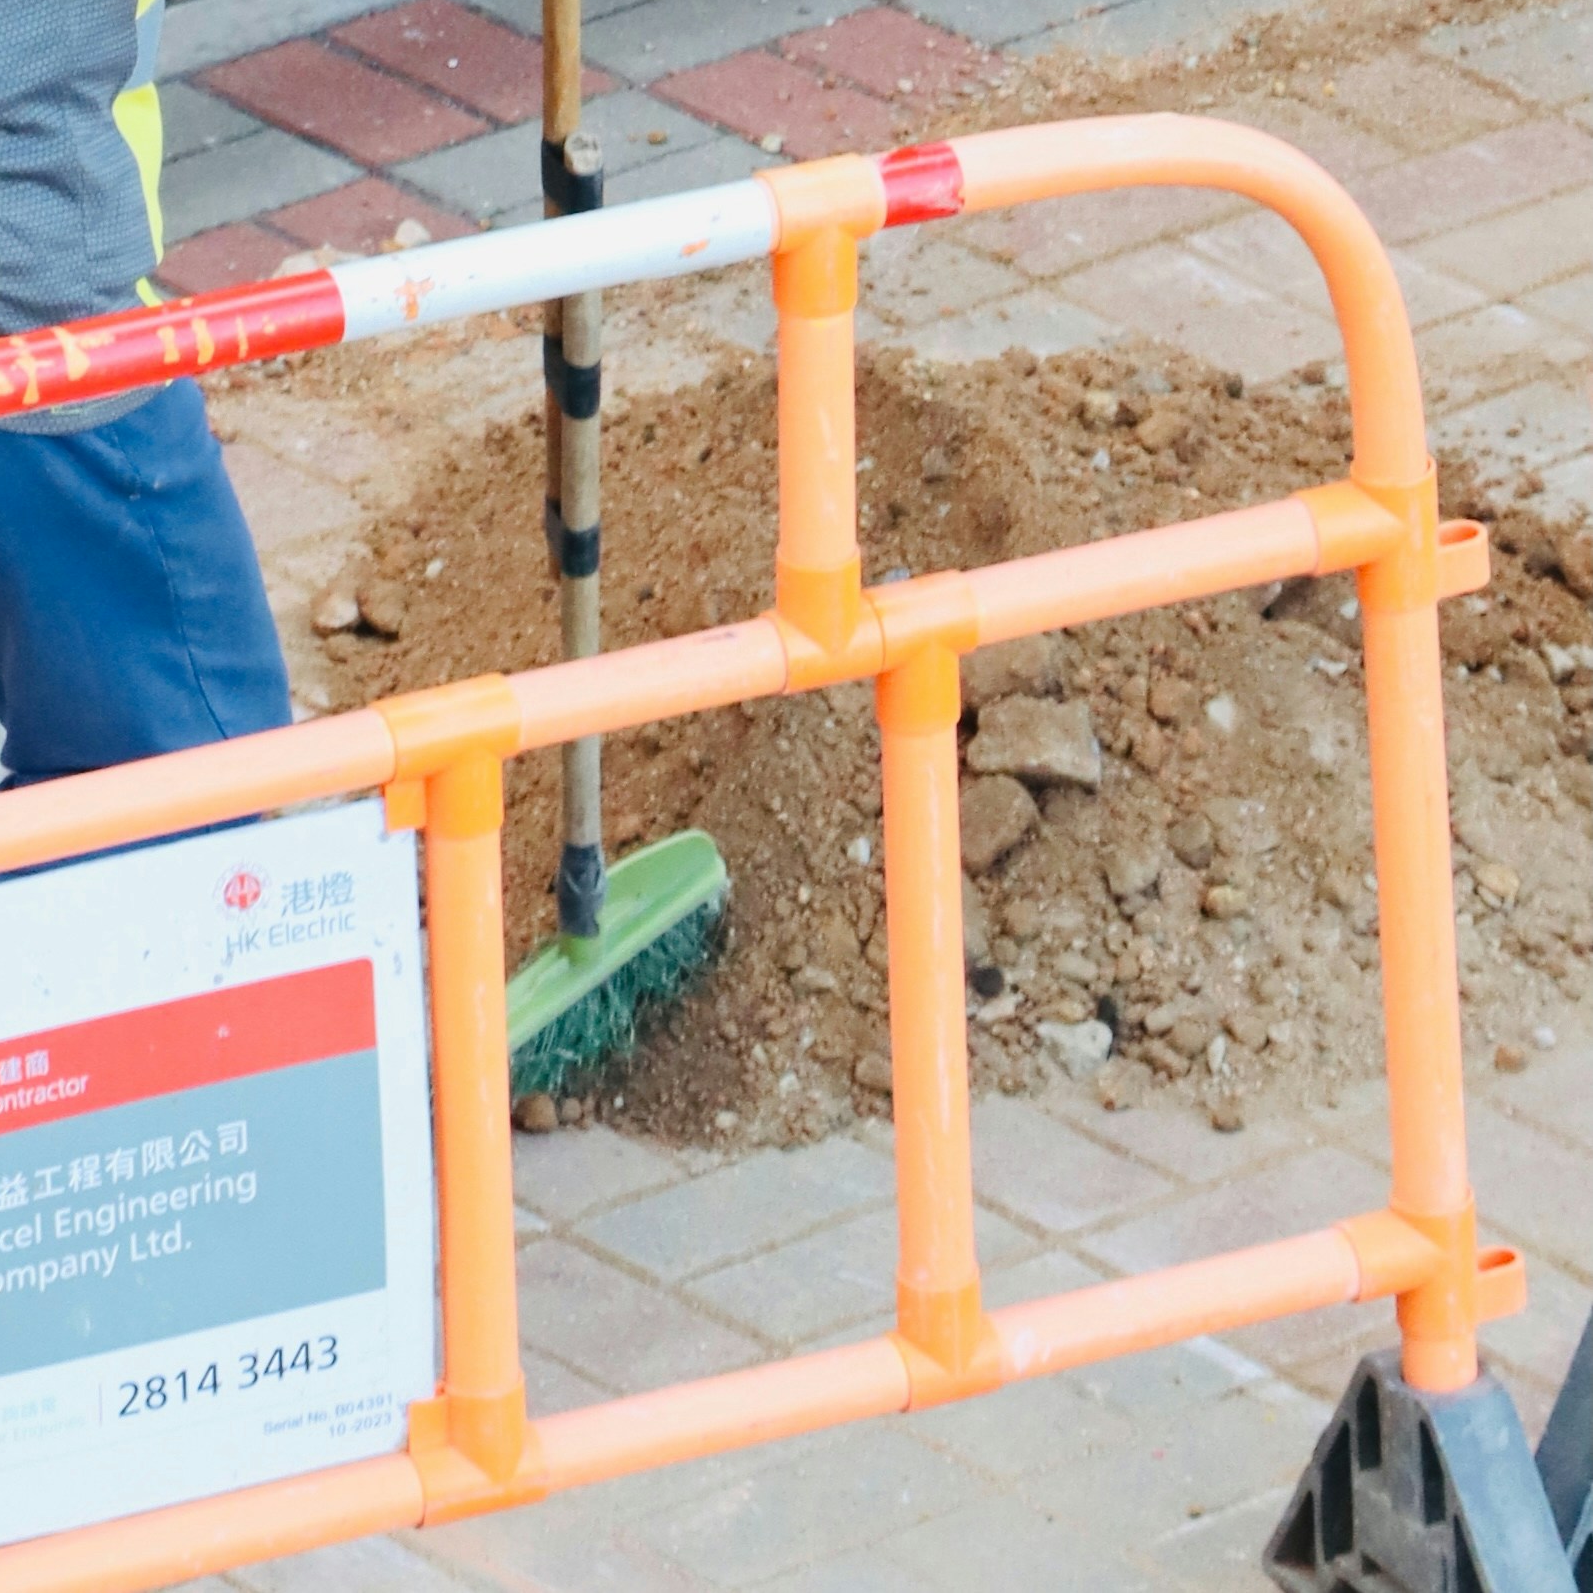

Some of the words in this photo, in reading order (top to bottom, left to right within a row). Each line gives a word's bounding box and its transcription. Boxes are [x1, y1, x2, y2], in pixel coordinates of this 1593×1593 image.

[281, 870, 355, 917] 港燈
[226, 928, 261, 956] HK
[269, 910, 356, 947] Electric
[55, 1170, 256, 1239] Engineering
[130, 1220, 192, 1262] Ltd.
[117, 1362, 222, 1418] 2814
[237, 1334, 339, 1390] 3443
